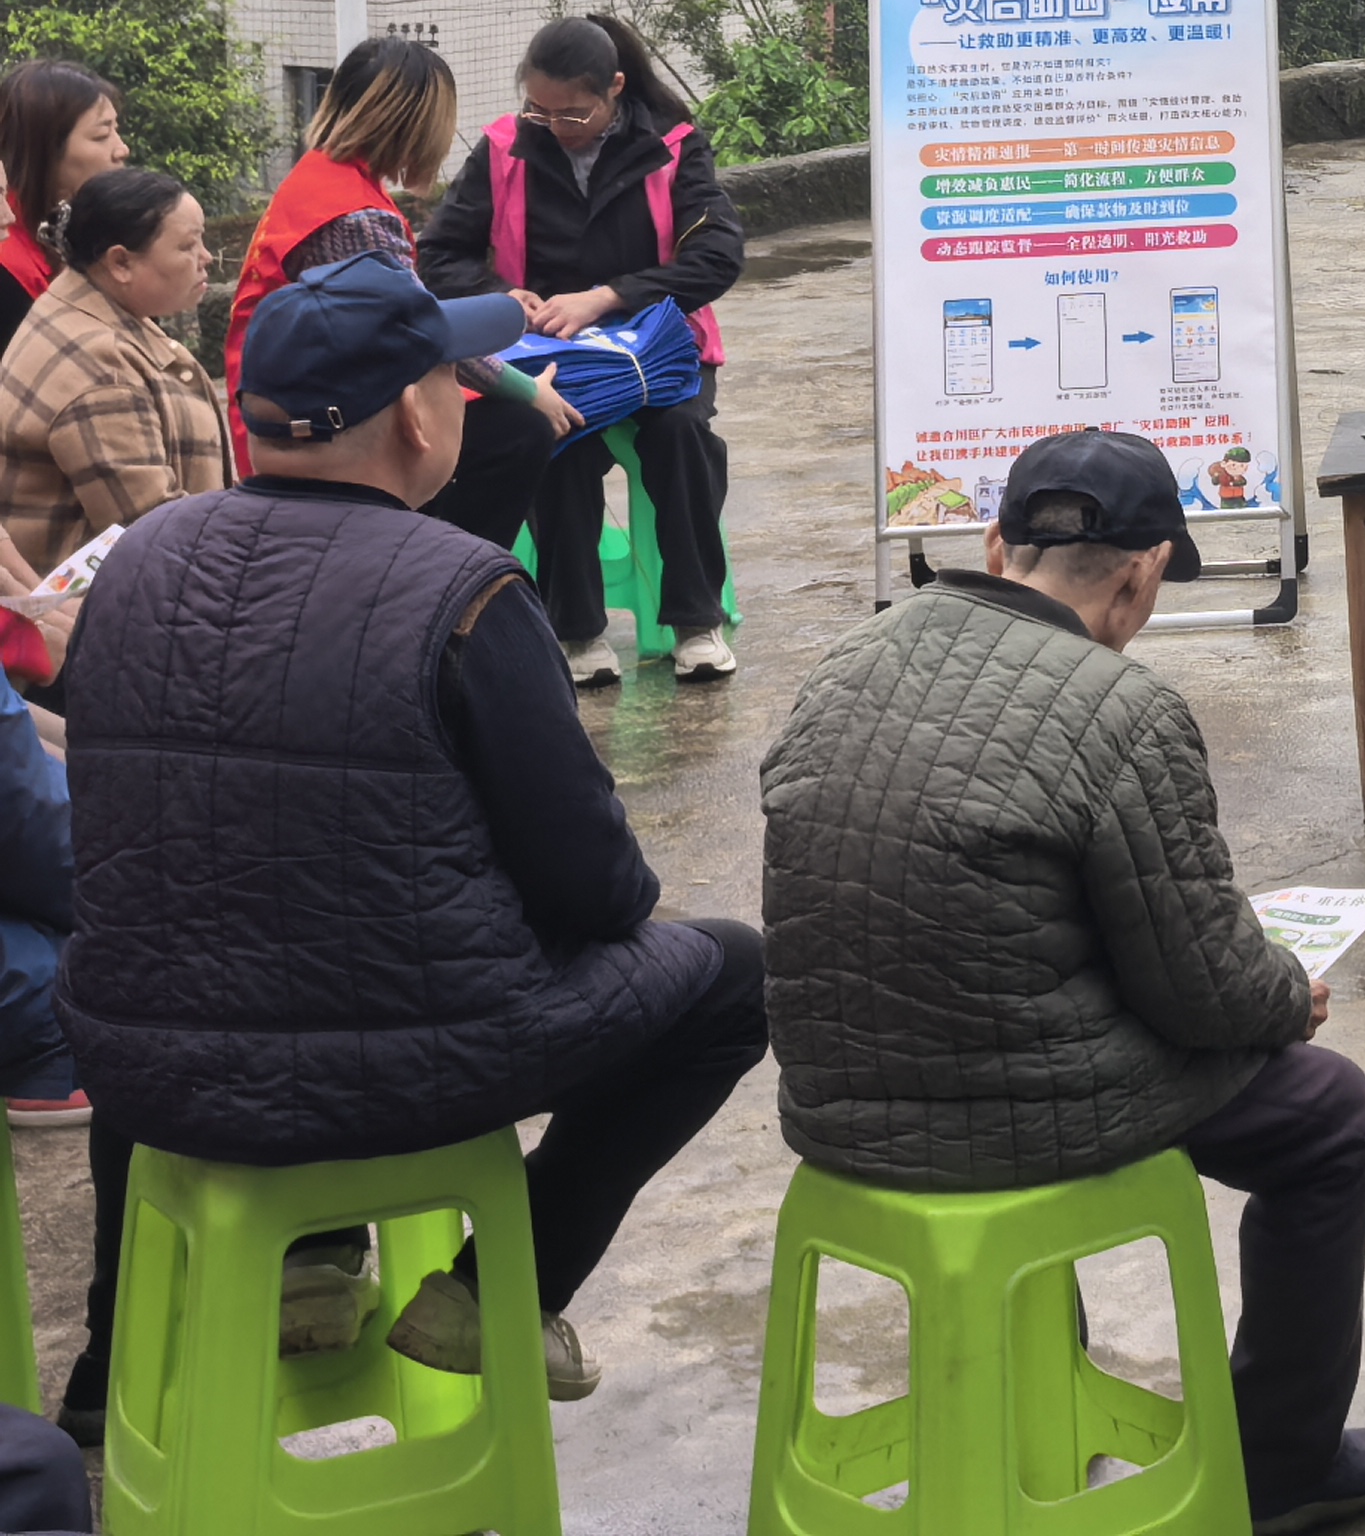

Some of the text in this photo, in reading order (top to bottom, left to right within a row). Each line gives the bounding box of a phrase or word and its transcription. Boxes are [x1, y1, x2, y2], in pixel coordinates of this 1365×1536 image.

[916, 445, 1030, 462] 让我们携手共建更
